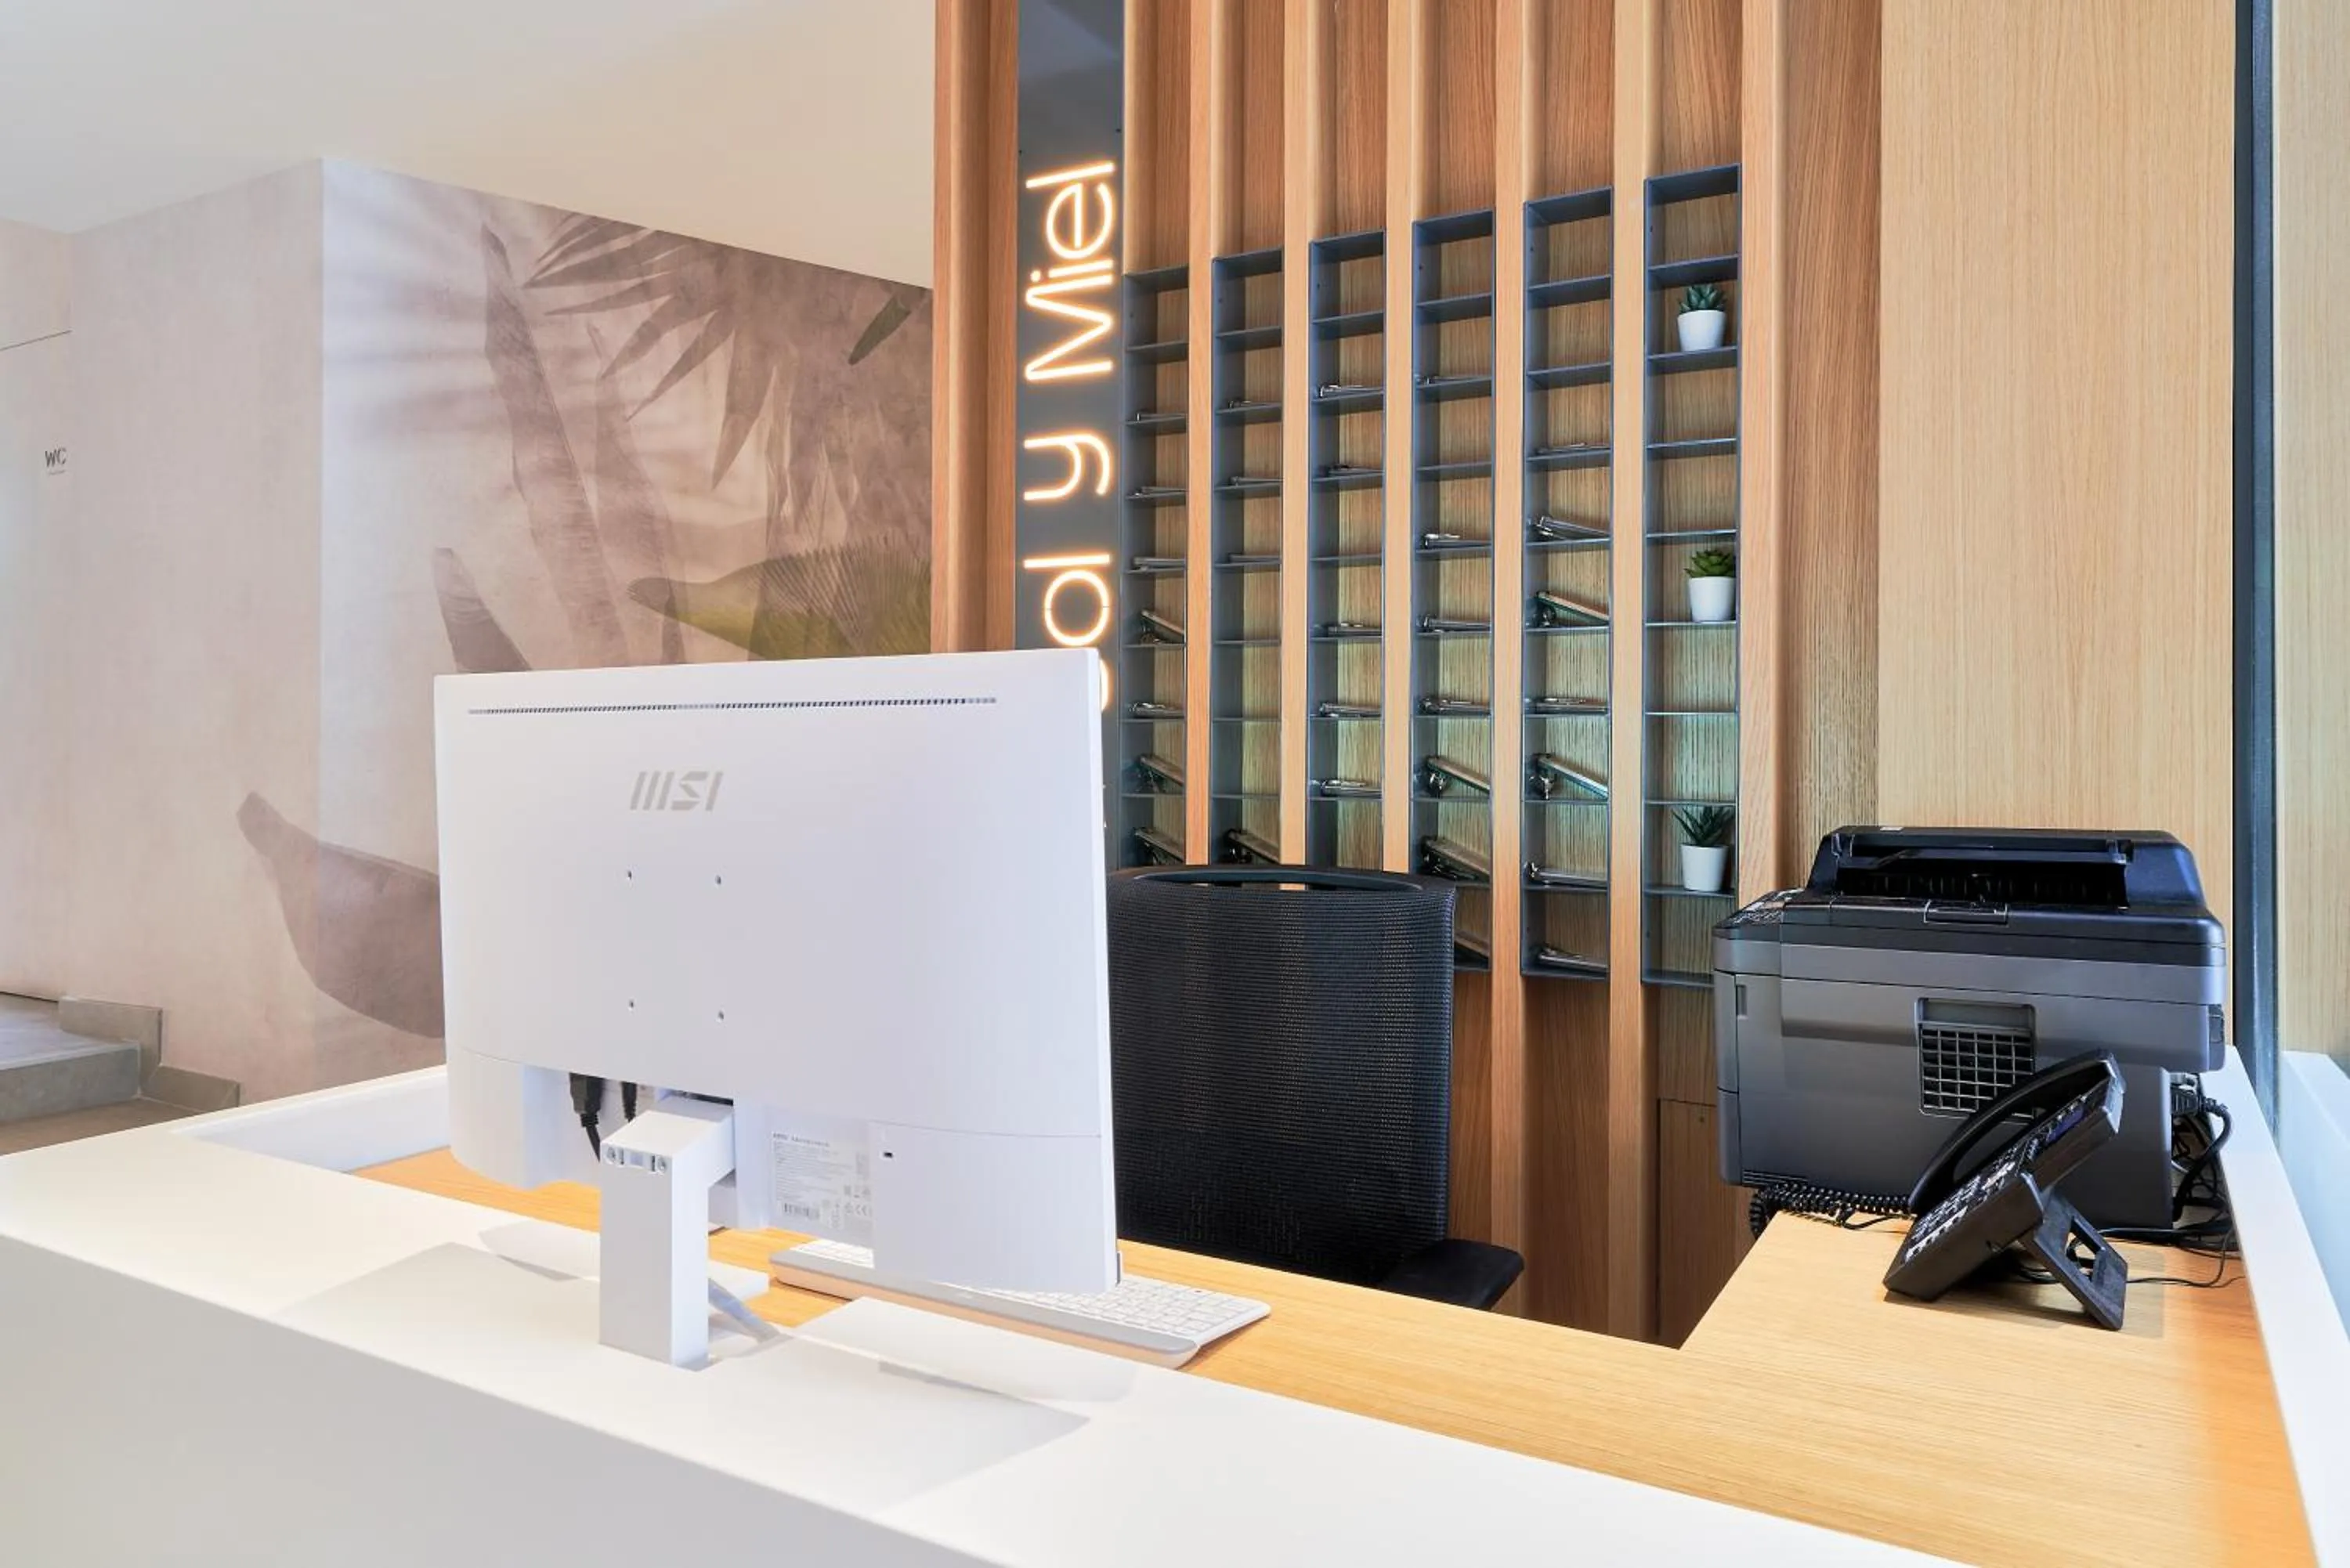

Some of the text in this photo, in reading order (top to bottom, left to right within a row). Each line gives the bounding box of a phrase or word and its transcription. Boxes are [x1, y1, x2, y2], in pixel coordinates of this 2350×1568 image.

[1024, 161, 1115, 712] ol y Miel
[45, 447, 67, 468] WC
[630, 771, 724, 811] MSI
